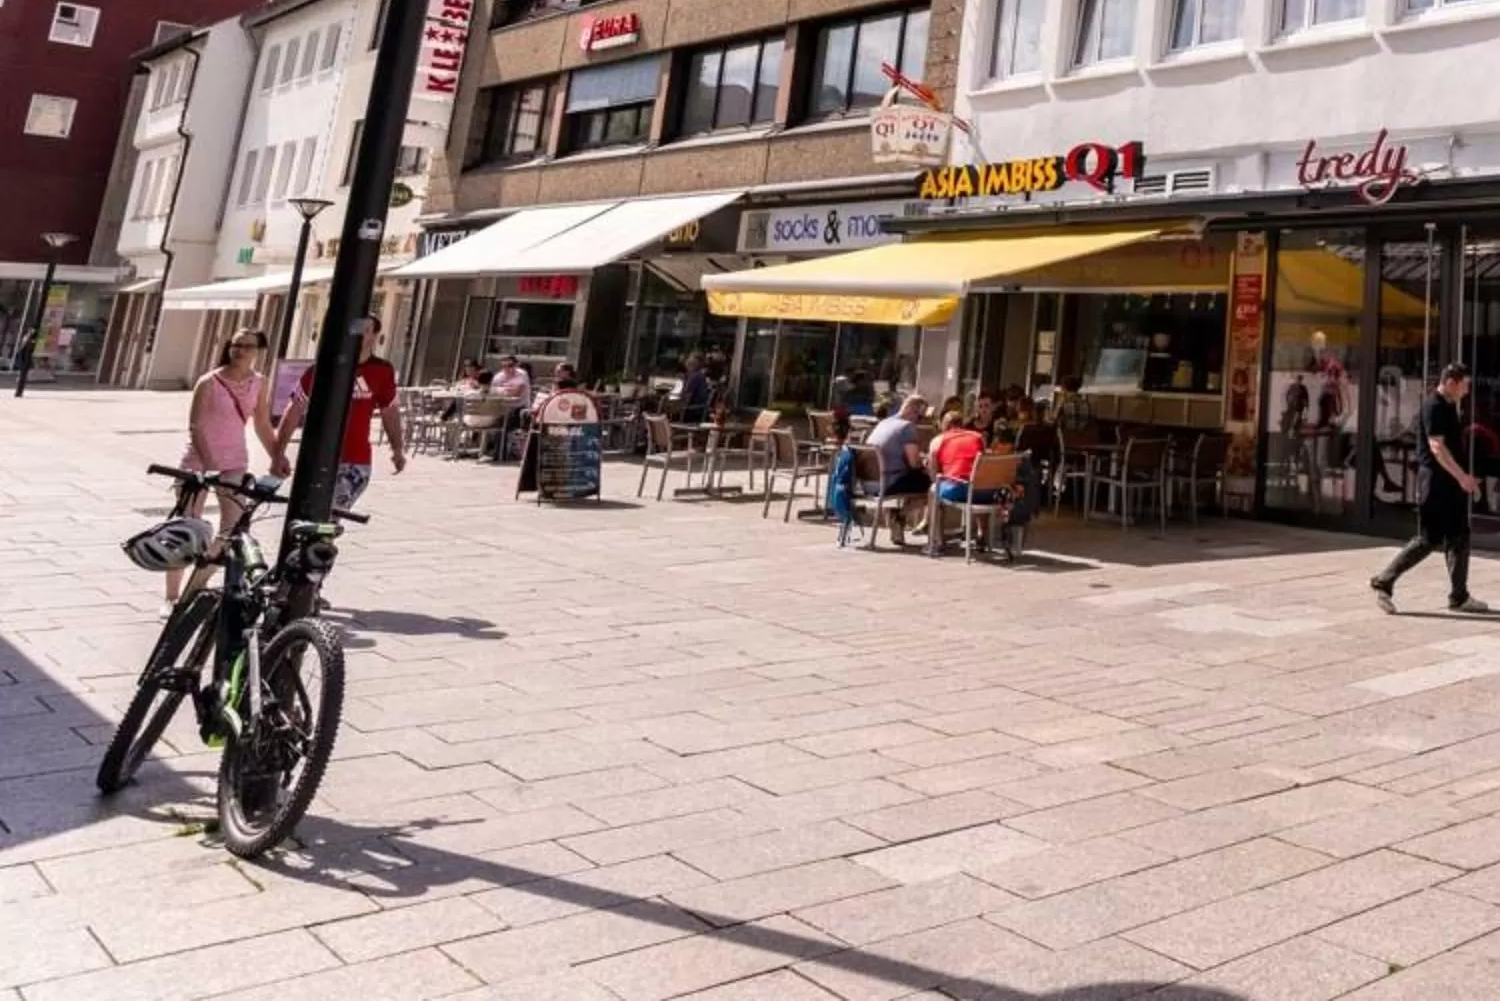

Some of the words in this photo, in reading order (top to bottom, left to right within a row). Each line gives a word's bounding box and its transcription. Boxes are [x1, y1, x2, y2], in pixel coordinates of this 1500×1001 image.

[920, 166, 974, 199] ASIA
[977, 156, 1060, 196] IMBISS
[1063, 142, 1143, 193] Q1
[1295, 127, 1418, 205] tredy
[773, 212, 820, 242] socks
[824, 208, 843, 245] &
